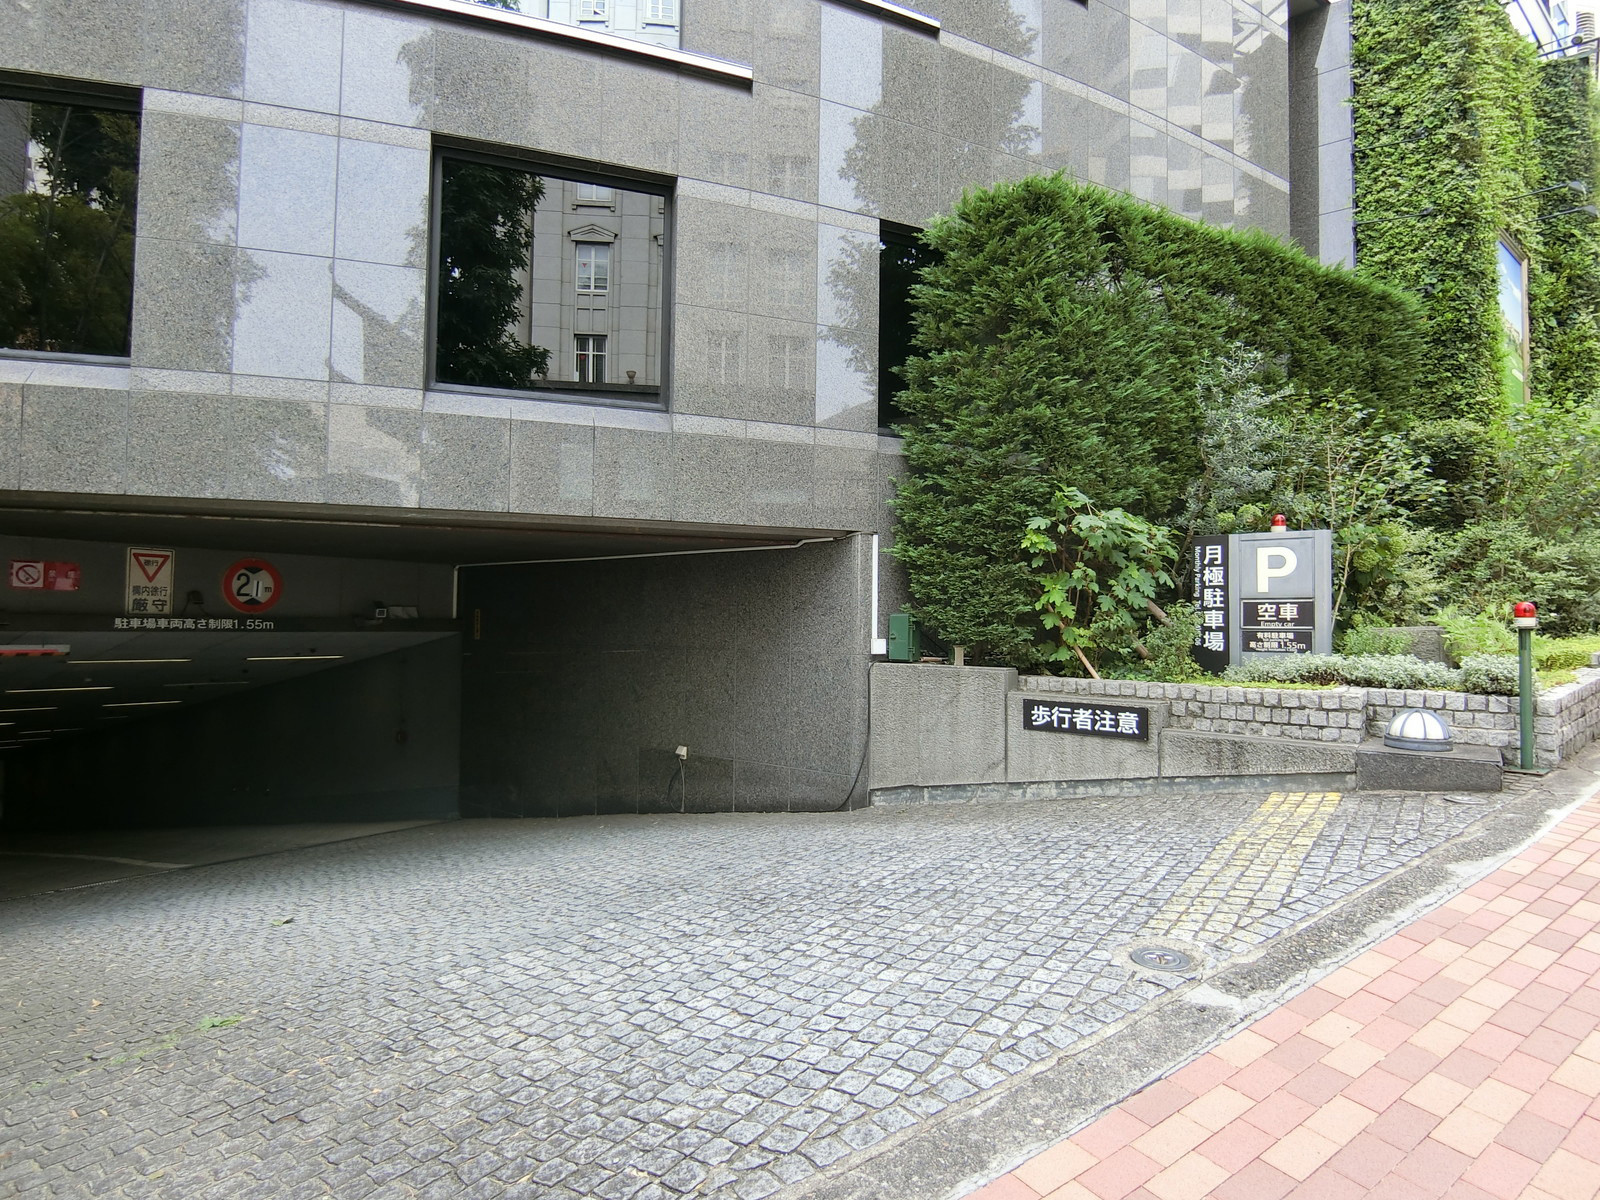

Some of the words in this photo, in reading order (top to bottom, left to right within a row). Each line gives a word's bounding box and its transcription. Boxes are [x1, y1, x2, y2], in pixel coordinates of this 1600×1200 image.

[1193, 546, 1201, 572] Monthly
[1256, 546, 1297, 593] P
[132, 585, 168, 597] 構内徐行
[1193, 574, 1201, 597] Parking
[132, 598, 168, 612] 厳守
[1203, 545, 1224, 651] 月極駐車場
[1257, 602, 1299, 621] 空車
[113, 617, 275, 631] 駐車場車両高さ制限1.55m
[1256, 631, 1294, 639] 有料駐車場
[1280, 640, 1306, 650] 1.55m
[1031, 705, 1139, 734] 歩行者注意
